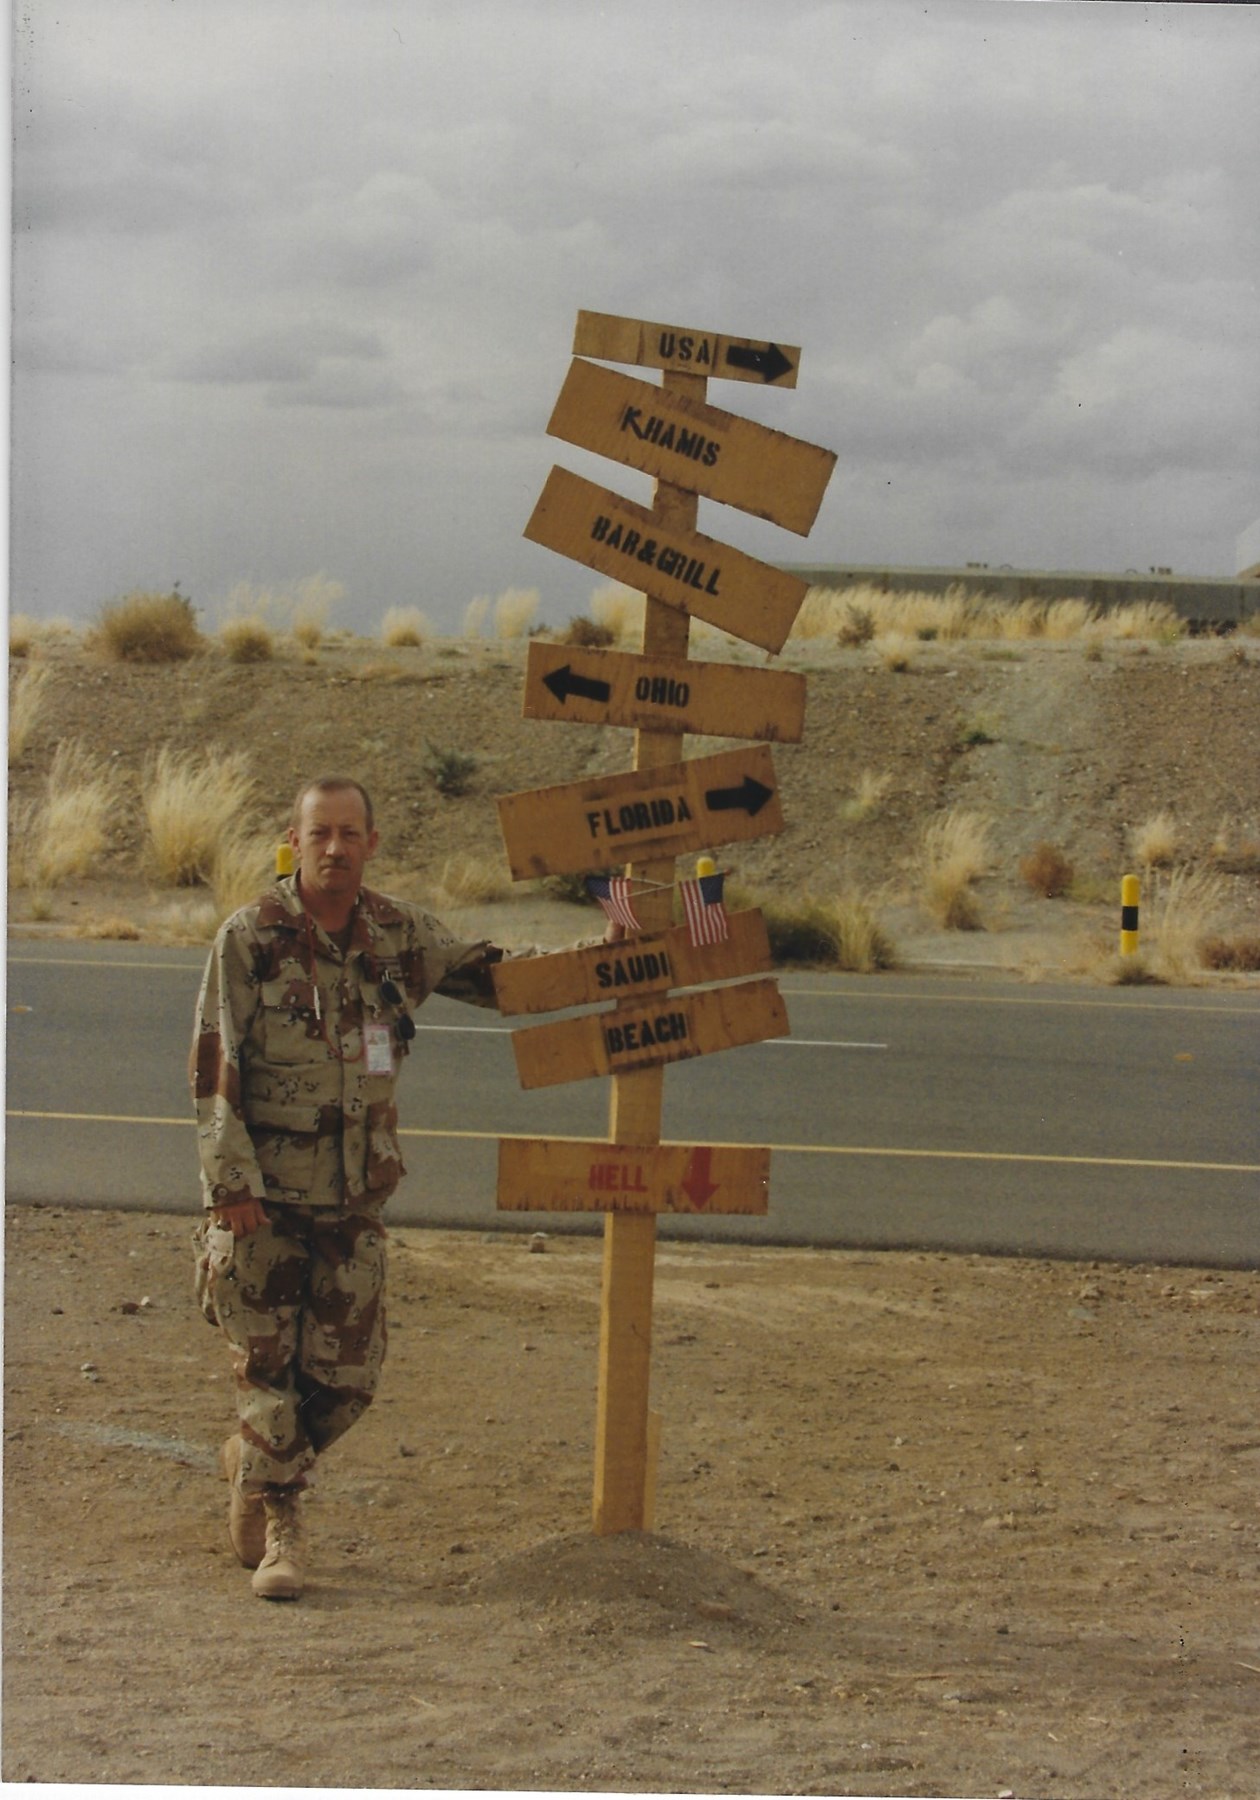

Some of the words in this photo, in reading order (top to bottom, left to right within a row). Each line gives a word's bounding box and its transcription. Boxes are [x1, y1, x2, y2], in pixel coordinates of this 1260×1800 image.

[658, 332, 711, 366] USA
[620, 405, 721, 467] KHAMIS
[591, 515, 721, 596] BAR&GRILL
[635, 676, 690, 708] OHIO
[586, 796, 693, 838] FLORIDA
[595, 951, 670, 988] SAUDI
[606, 1012, 687, 1054] BEACH
[588, 1164, 648, 1192] HELL
